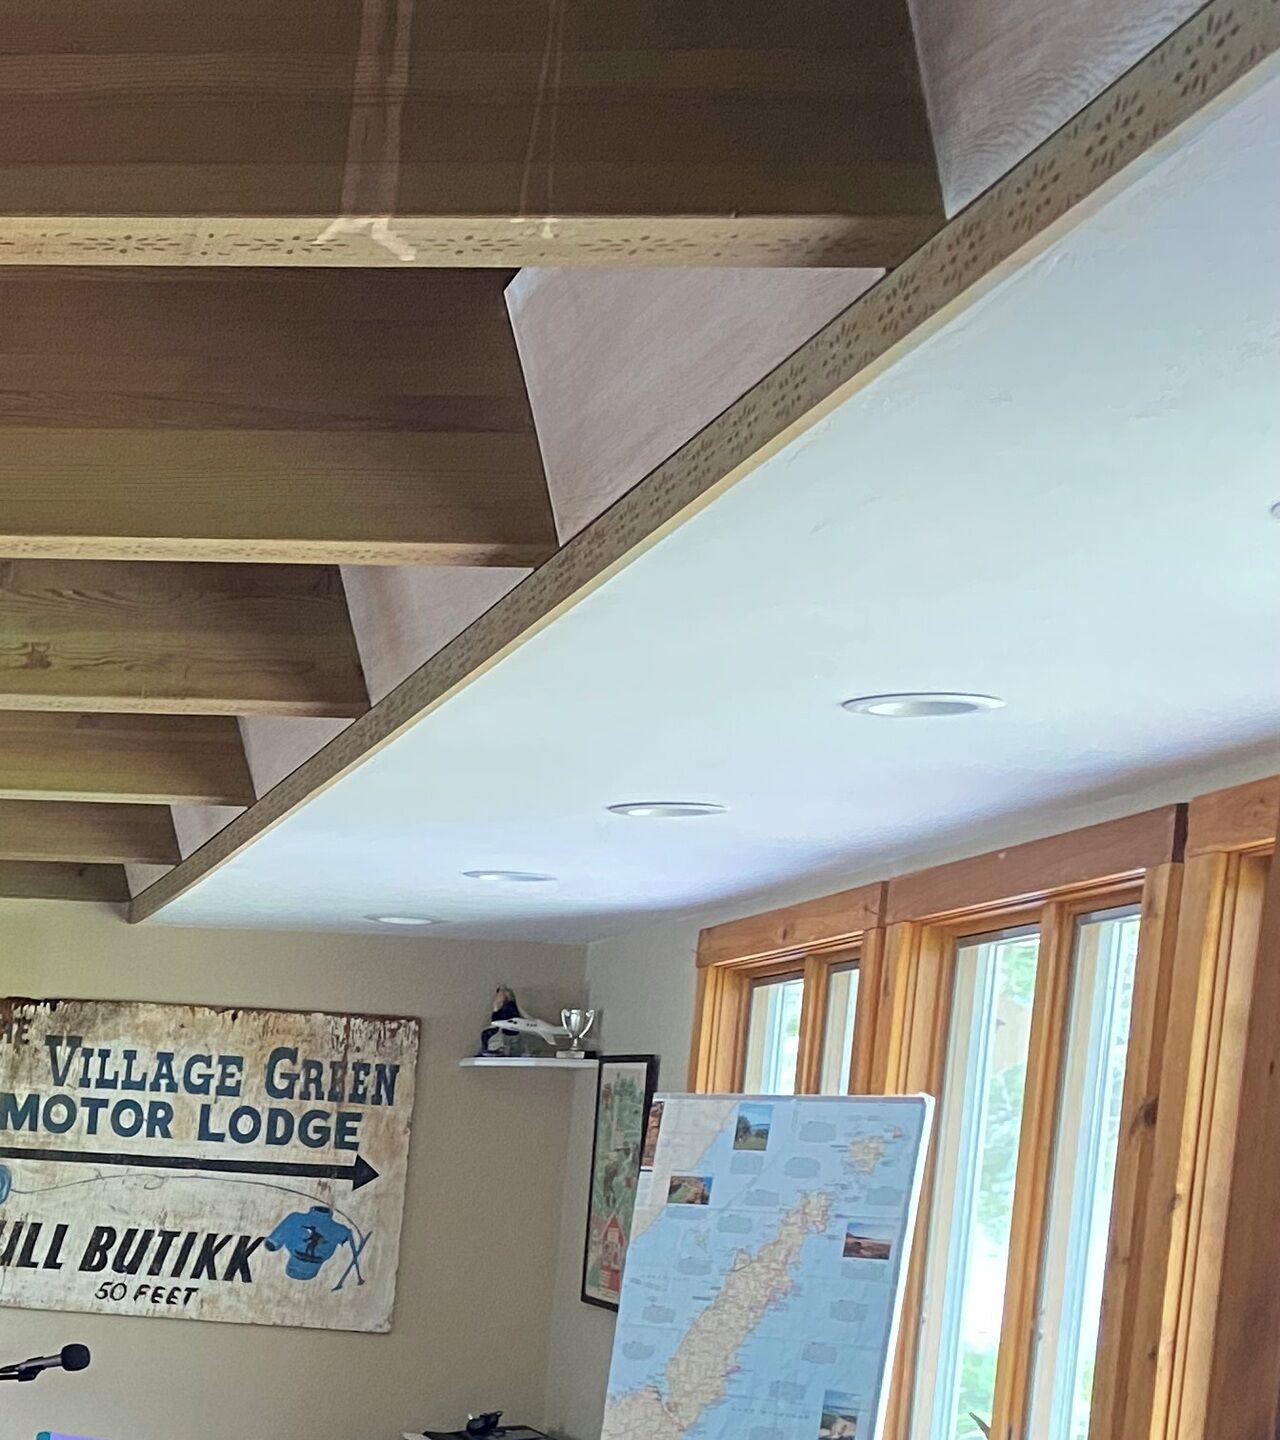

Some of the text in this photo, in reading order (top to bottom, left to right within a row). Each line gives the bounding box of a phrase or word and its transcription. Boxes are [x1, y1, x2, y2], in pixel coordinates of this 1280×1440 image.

[45, 1034, 400, 1107] VILLAGE GREEN
[197, 1103, 363, 1151] LODGE
[78, 1225, 266, 1283] BUTIKK
[95, 1281, 199, 1306] 50 FEET
